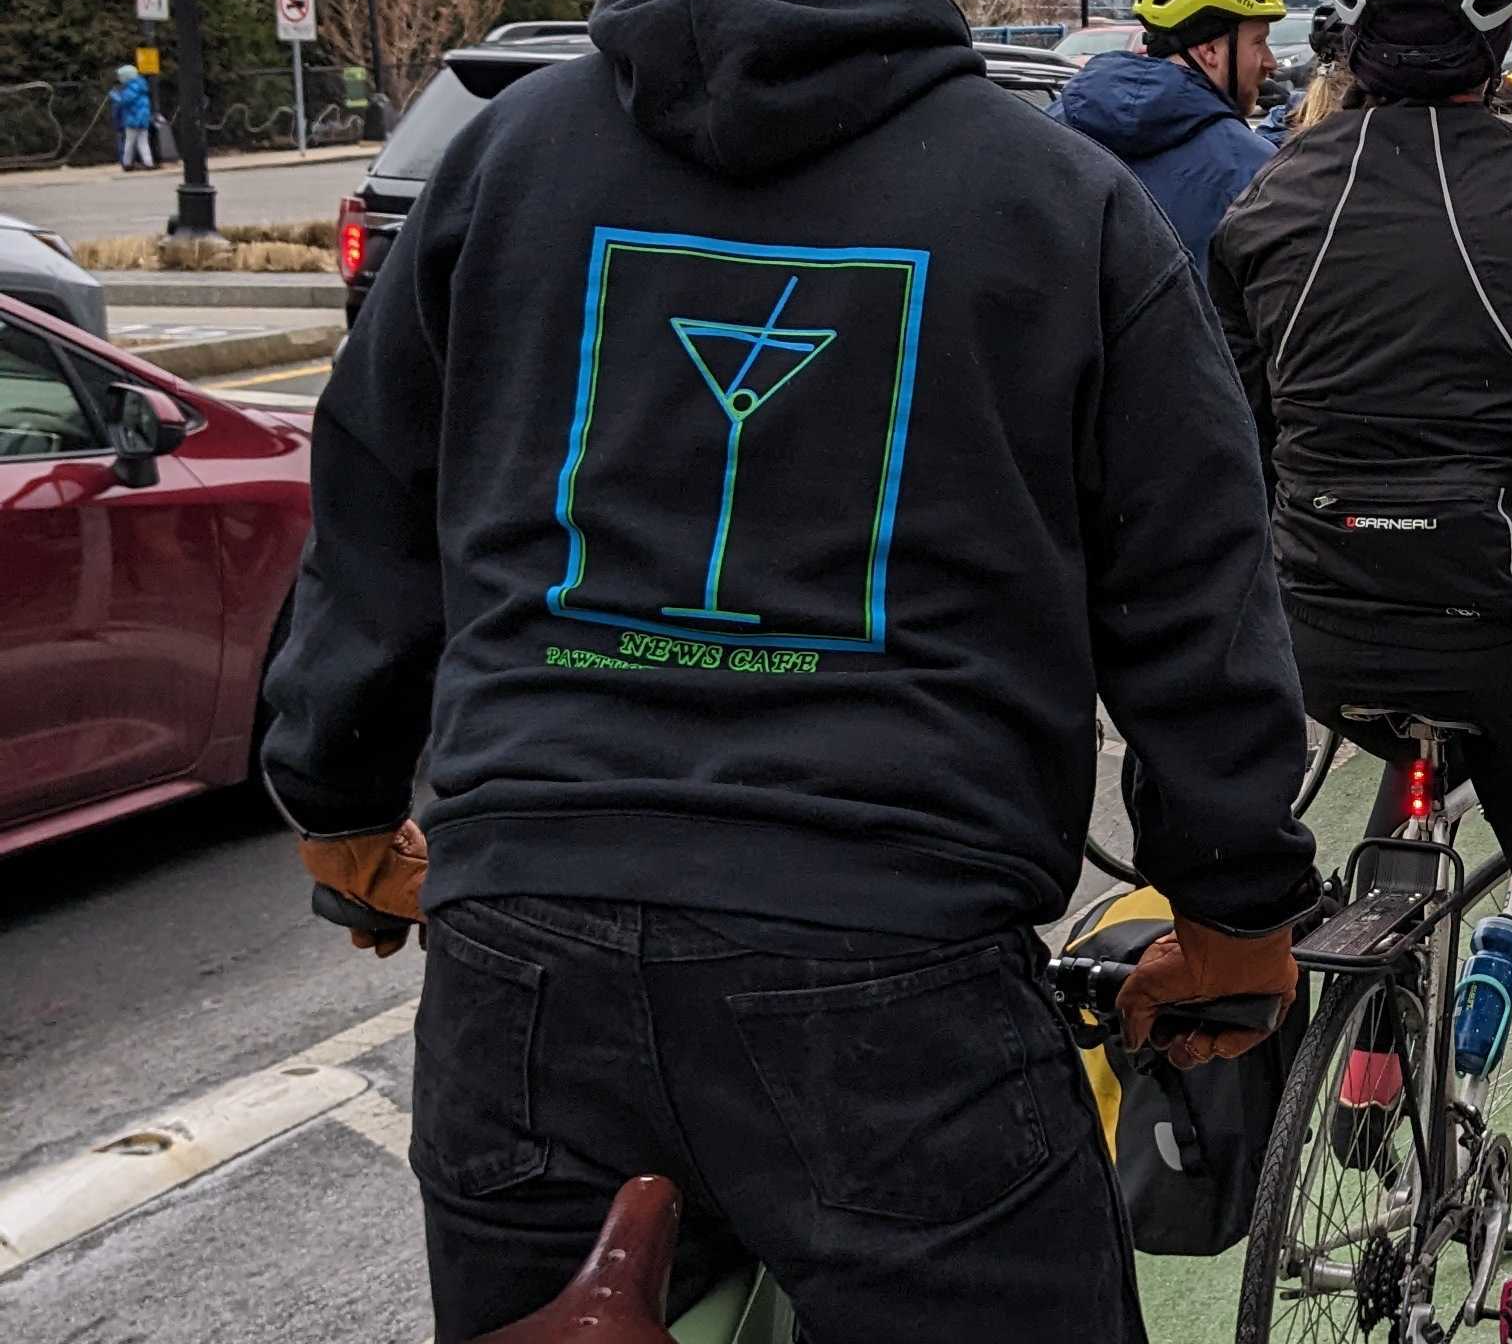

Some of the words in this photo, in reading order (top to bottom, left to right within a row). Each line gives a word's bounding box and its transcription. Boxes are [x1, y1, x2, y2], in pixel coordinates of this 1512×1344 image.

[1354, 517, 1438, 530] GARNEAU
[619, 631, 723, 669] NEWS
[728, 648, 819, 673] CAFE
